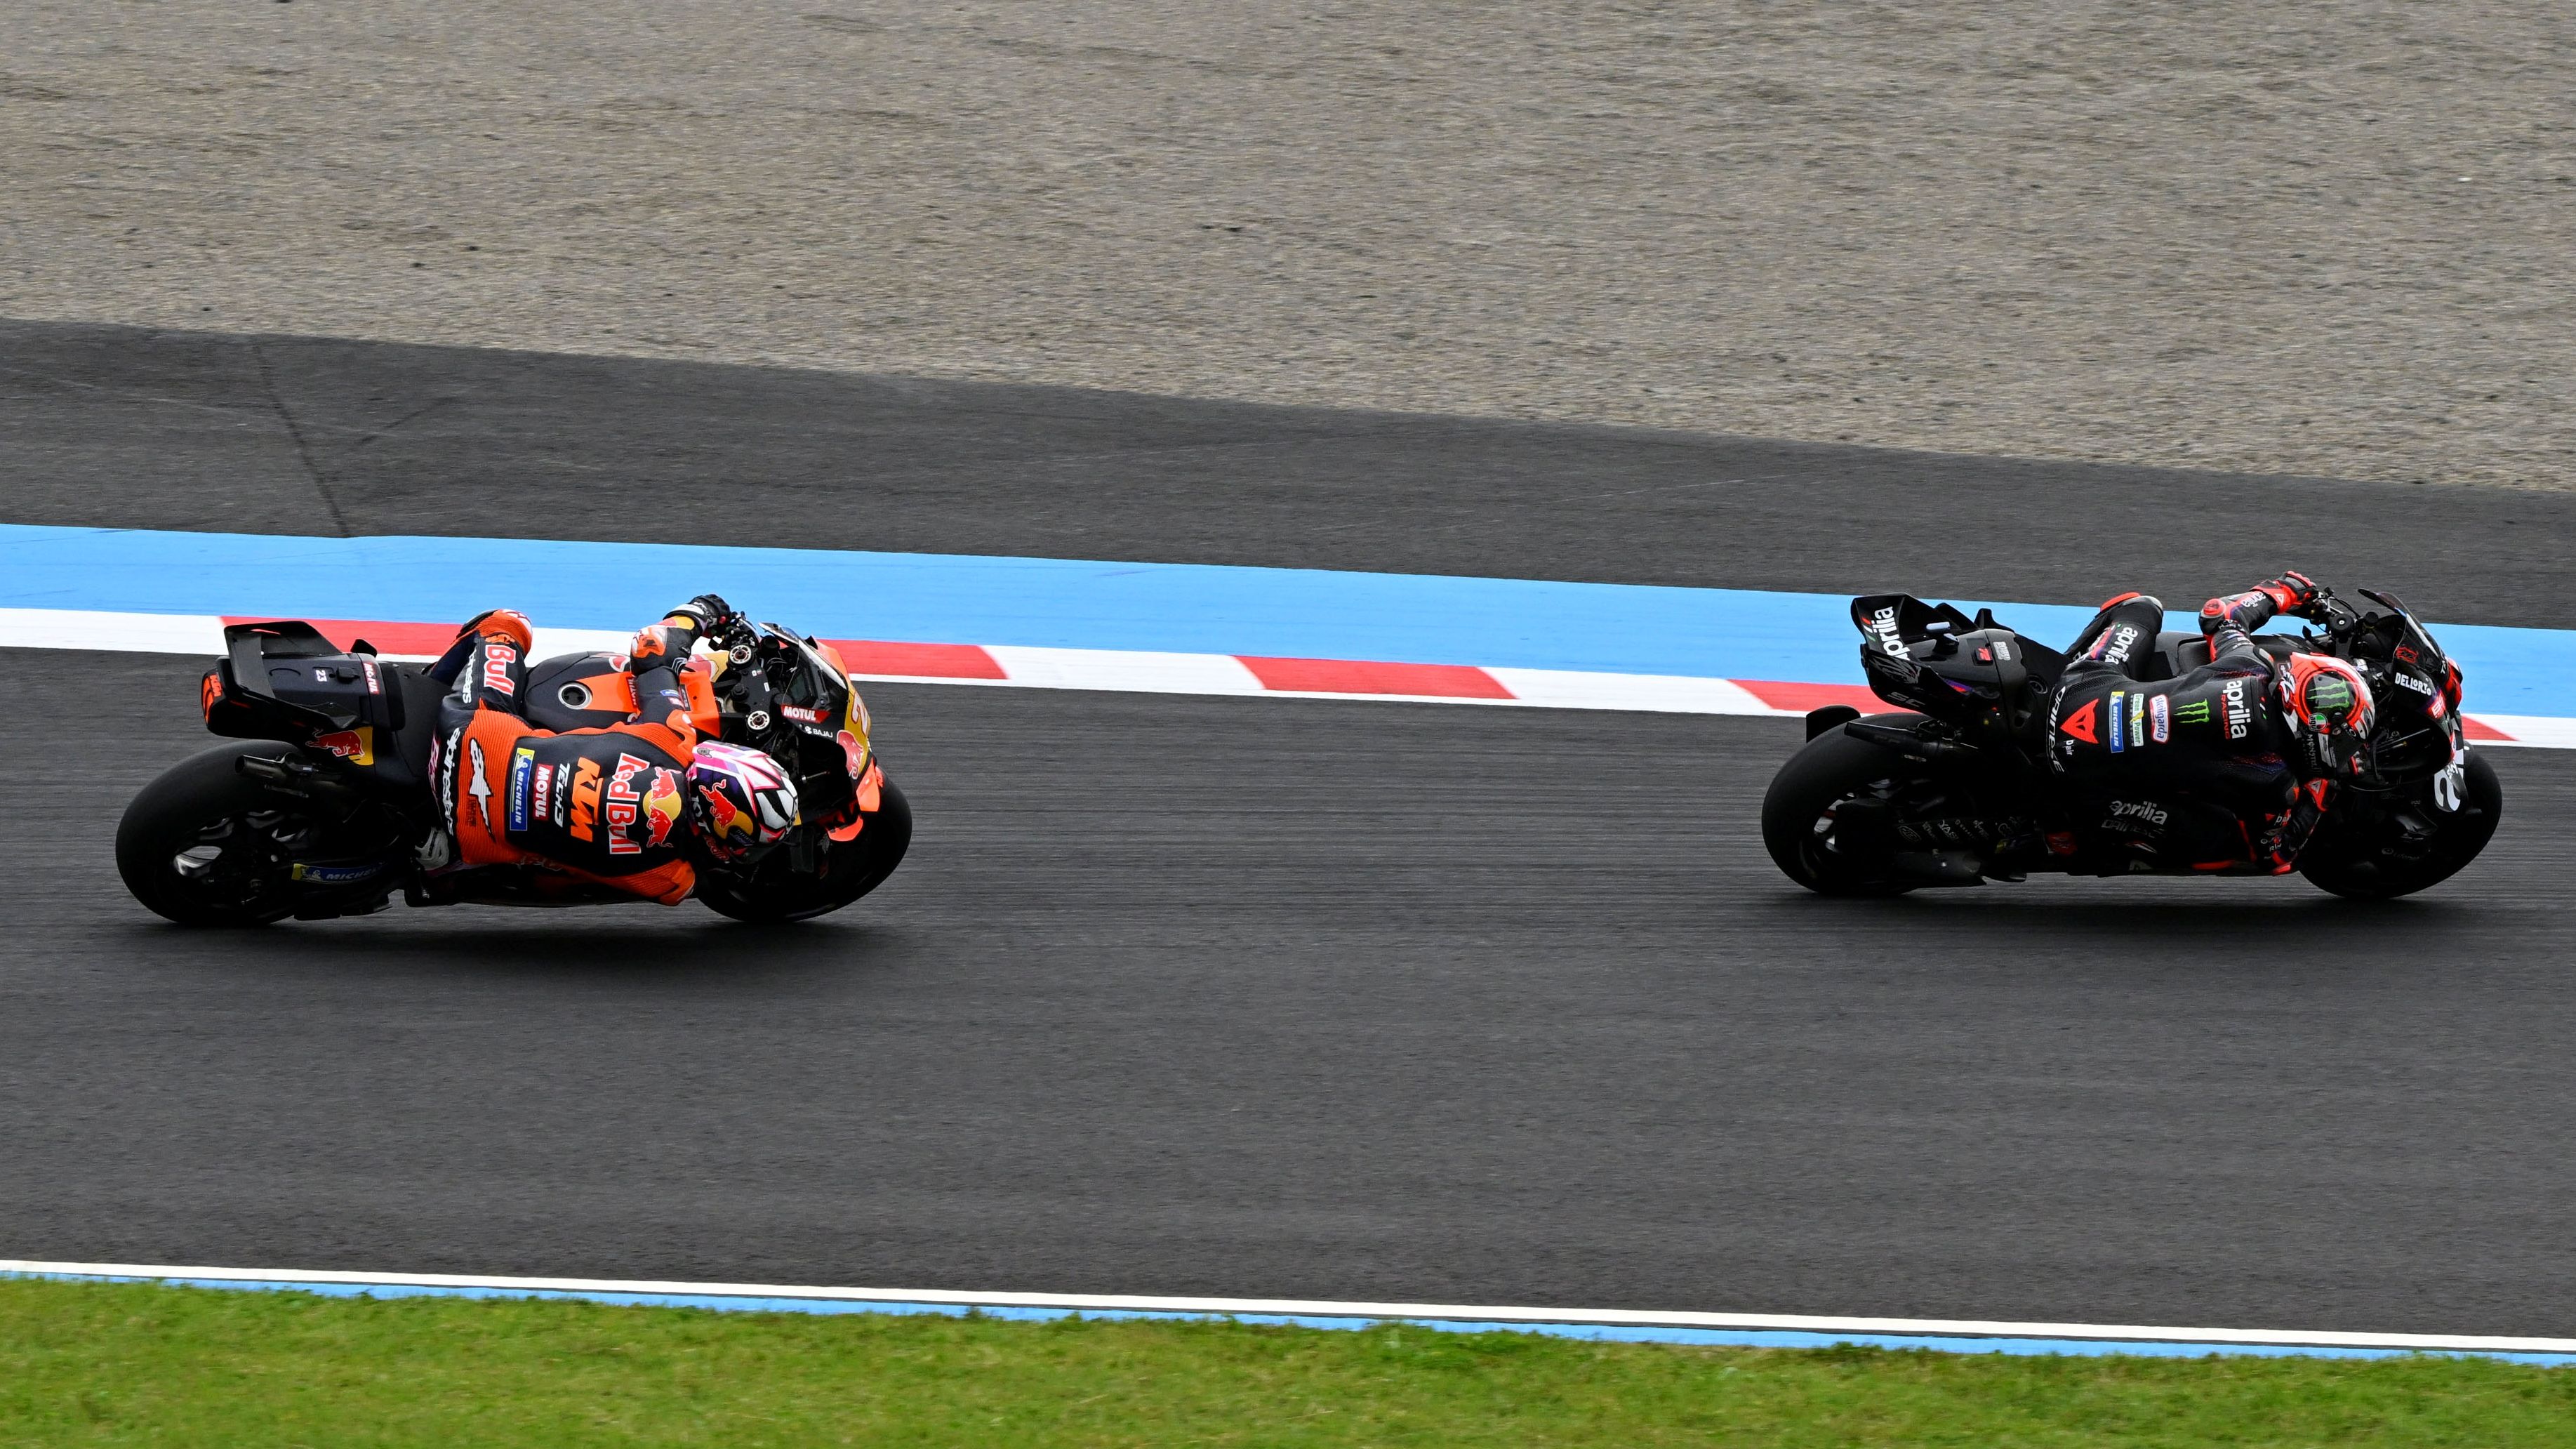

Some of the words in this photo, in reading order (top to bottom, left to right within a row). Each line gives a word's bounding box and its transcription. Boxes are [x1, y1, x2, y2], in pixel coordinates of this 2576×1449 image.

[316, 669, 327, 682] 23
[364, 663, 379, 694] MOTUL
[463, 647, 477, 703] pinestars
[485, 644, 517, 697] Bull
[783, 706, 816, 721] MOTUL
[813, 729, 833, 738] BAJAJ
[2221, 694, 2231, 740] RACING
[2223, 680, 2251, 739] aprilia
[442, 727, 461, 836] alpinestars
[514, 770, 525, 824] MICHELIN
[535, 766, 551, 819] MOTUL
[554, 762, 571, 828] TECH3
[570, 756, 605, 842] KTM
[606, 752, 651, 802] Red
[606, 802, 642, 854] Bull
[2109, 800, 2168, 825] aprilia
